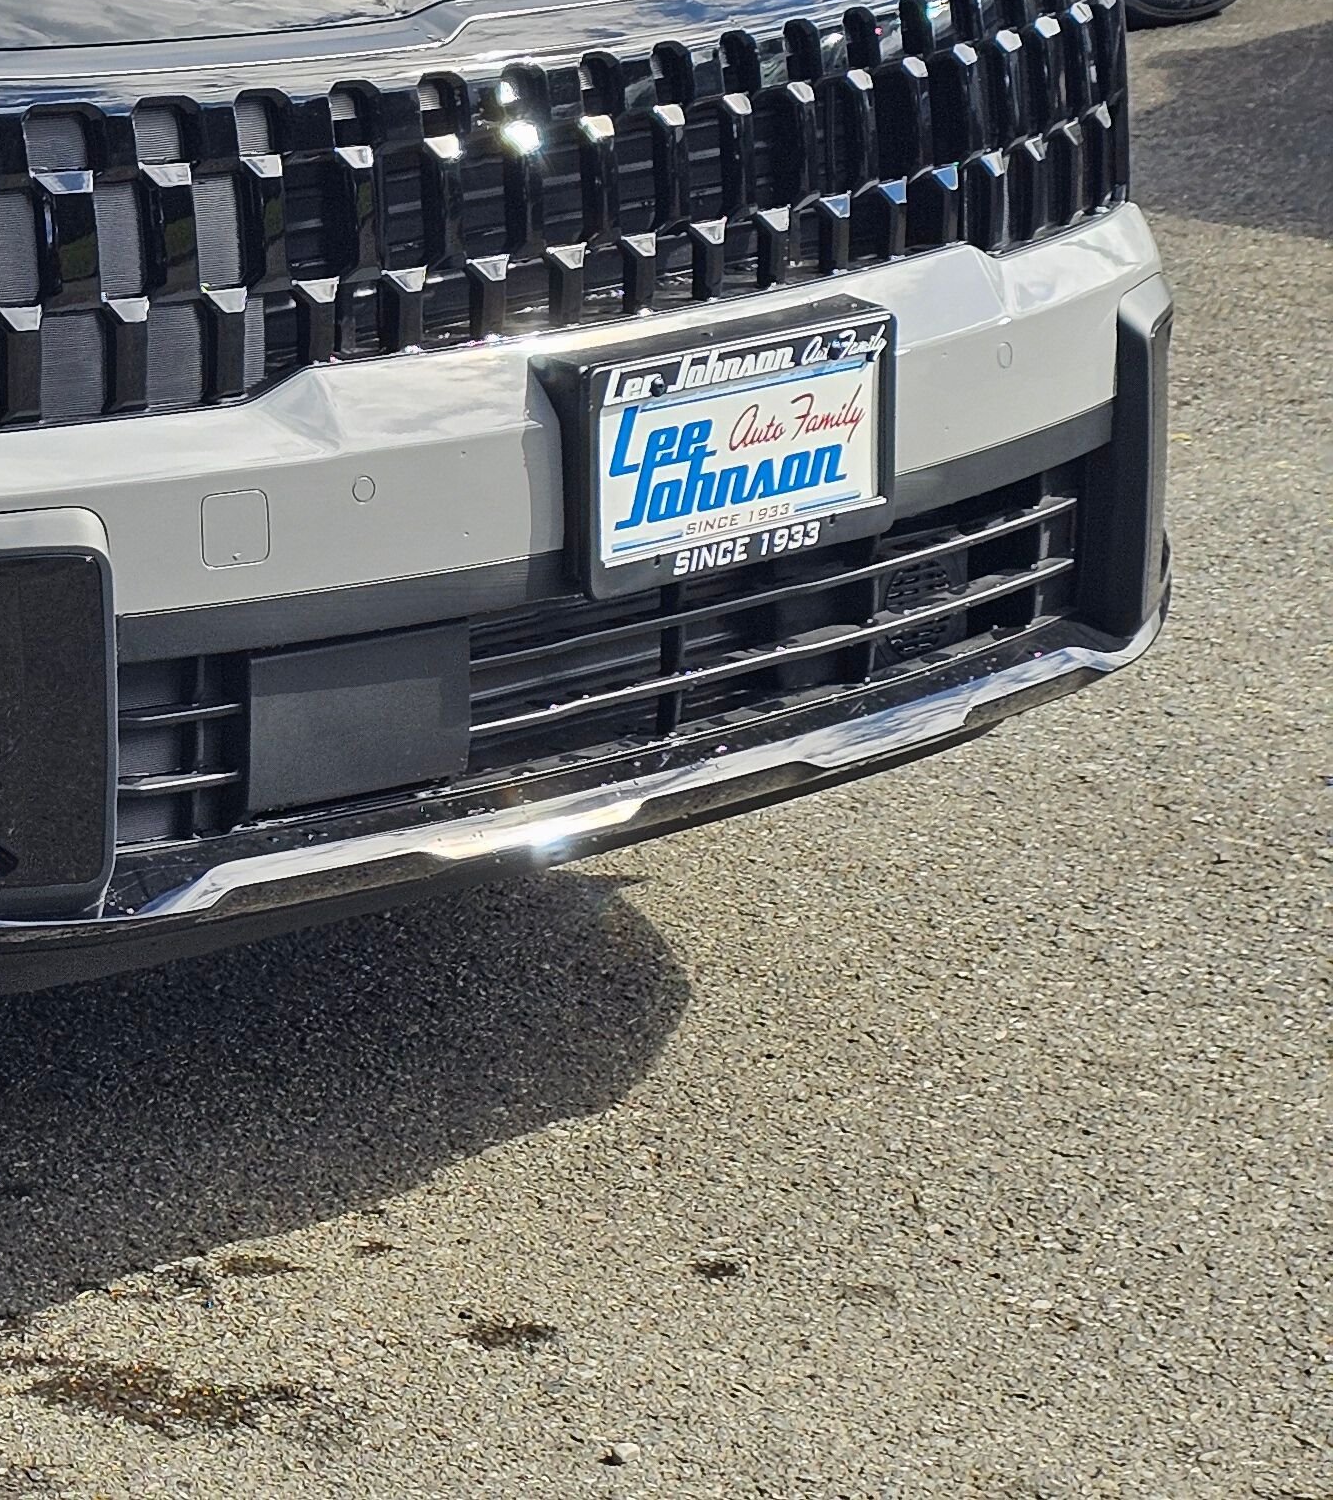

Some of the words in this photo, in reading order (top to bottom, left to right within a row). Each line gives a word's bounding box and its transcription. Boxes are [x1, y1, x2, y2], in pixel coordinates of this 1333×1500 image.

[667, 347, 795, 394] Johnson
[609, 405, 717, 477] Lee
[729, 404, 786, 451] Auto
[791, 384, 865, 443] Family
[614, 444, 847, 531] Johnson
[686, 513, 739, 536] SINCE
[749, 502, 790, 523] 1933
[673, 538, 749, 576] SINCE
[760, 521, 820, 556] 1933
